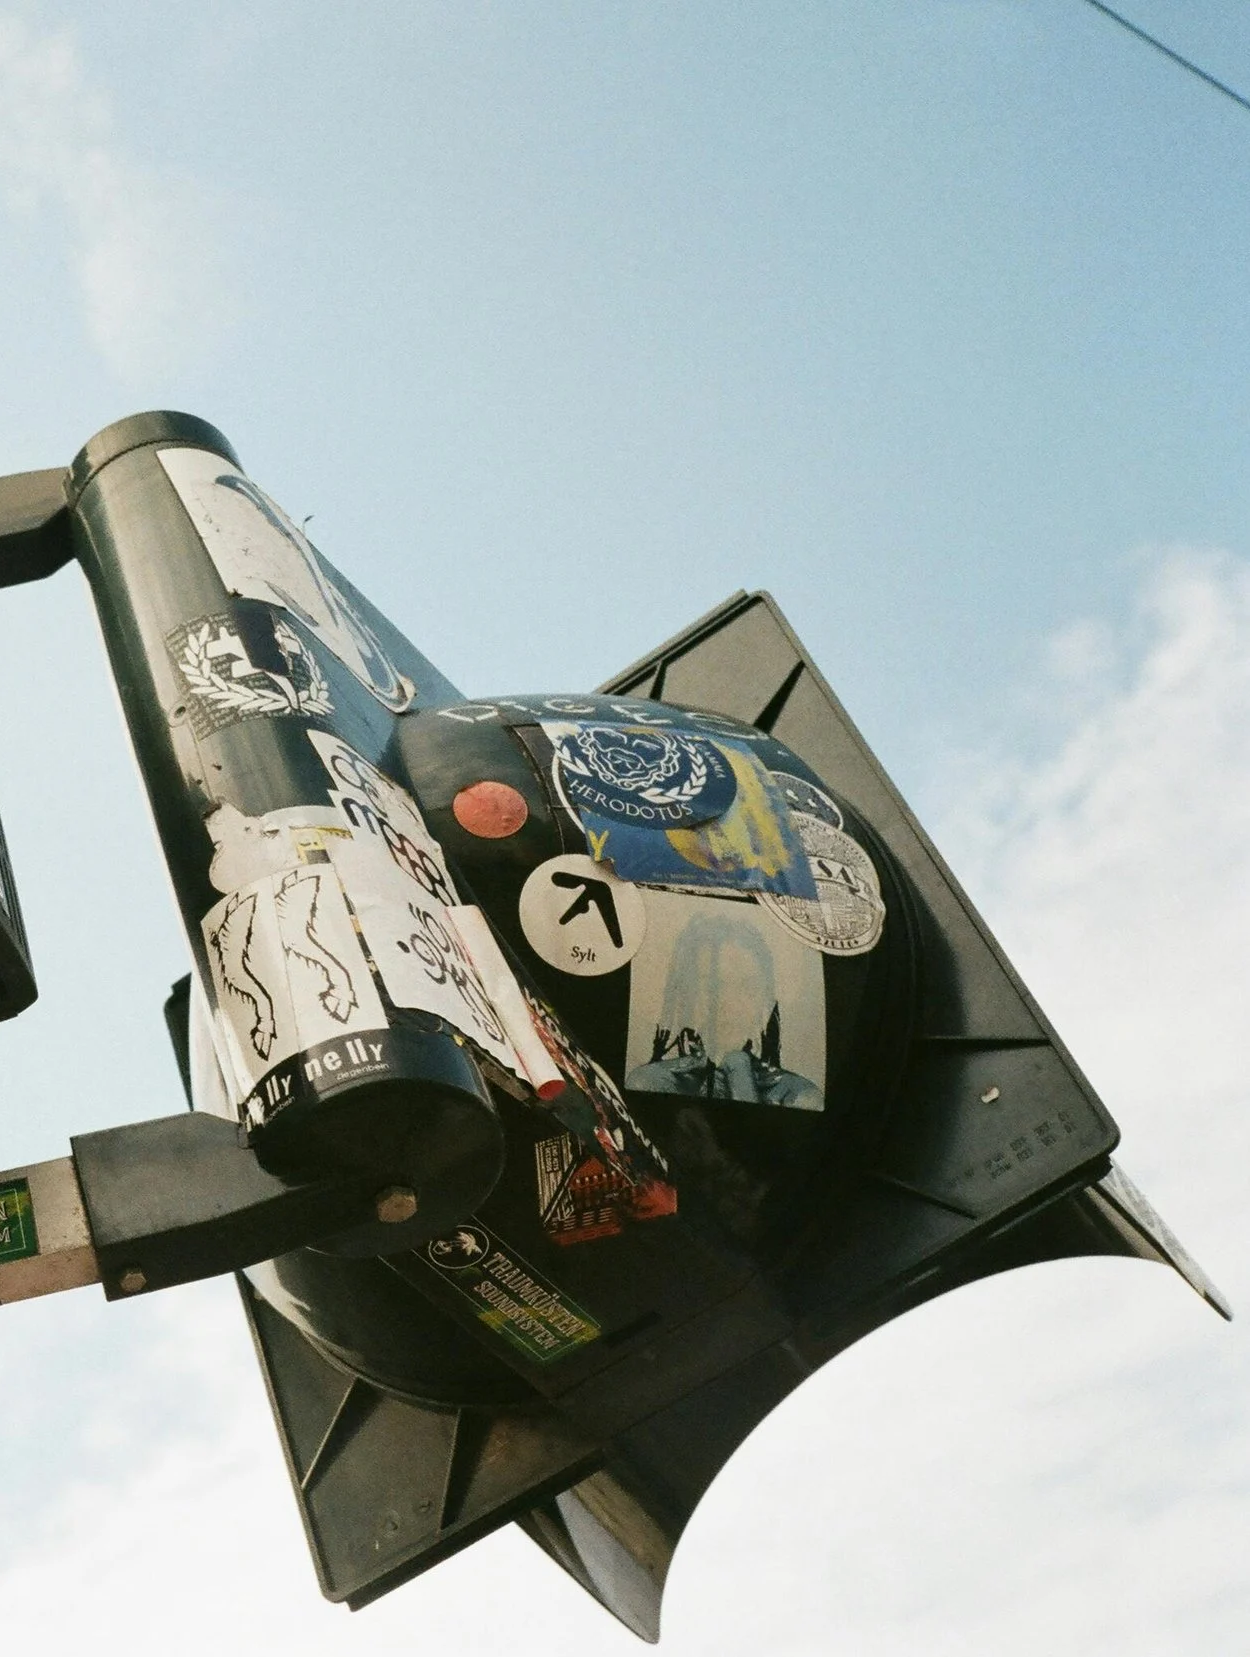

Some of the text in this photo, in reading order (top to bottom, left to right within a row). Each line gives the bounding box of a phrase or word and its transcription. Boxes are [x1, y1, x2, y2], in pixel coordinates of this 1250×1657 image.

[569, 779, 694, 821] HERODOTUS
[570, 945, 596, 963] Sylt
[474, 1280, 560, 1350] SOUNDSYSTEM
[482, 1251, 587, 1338] TRAUMKÜSTEN
